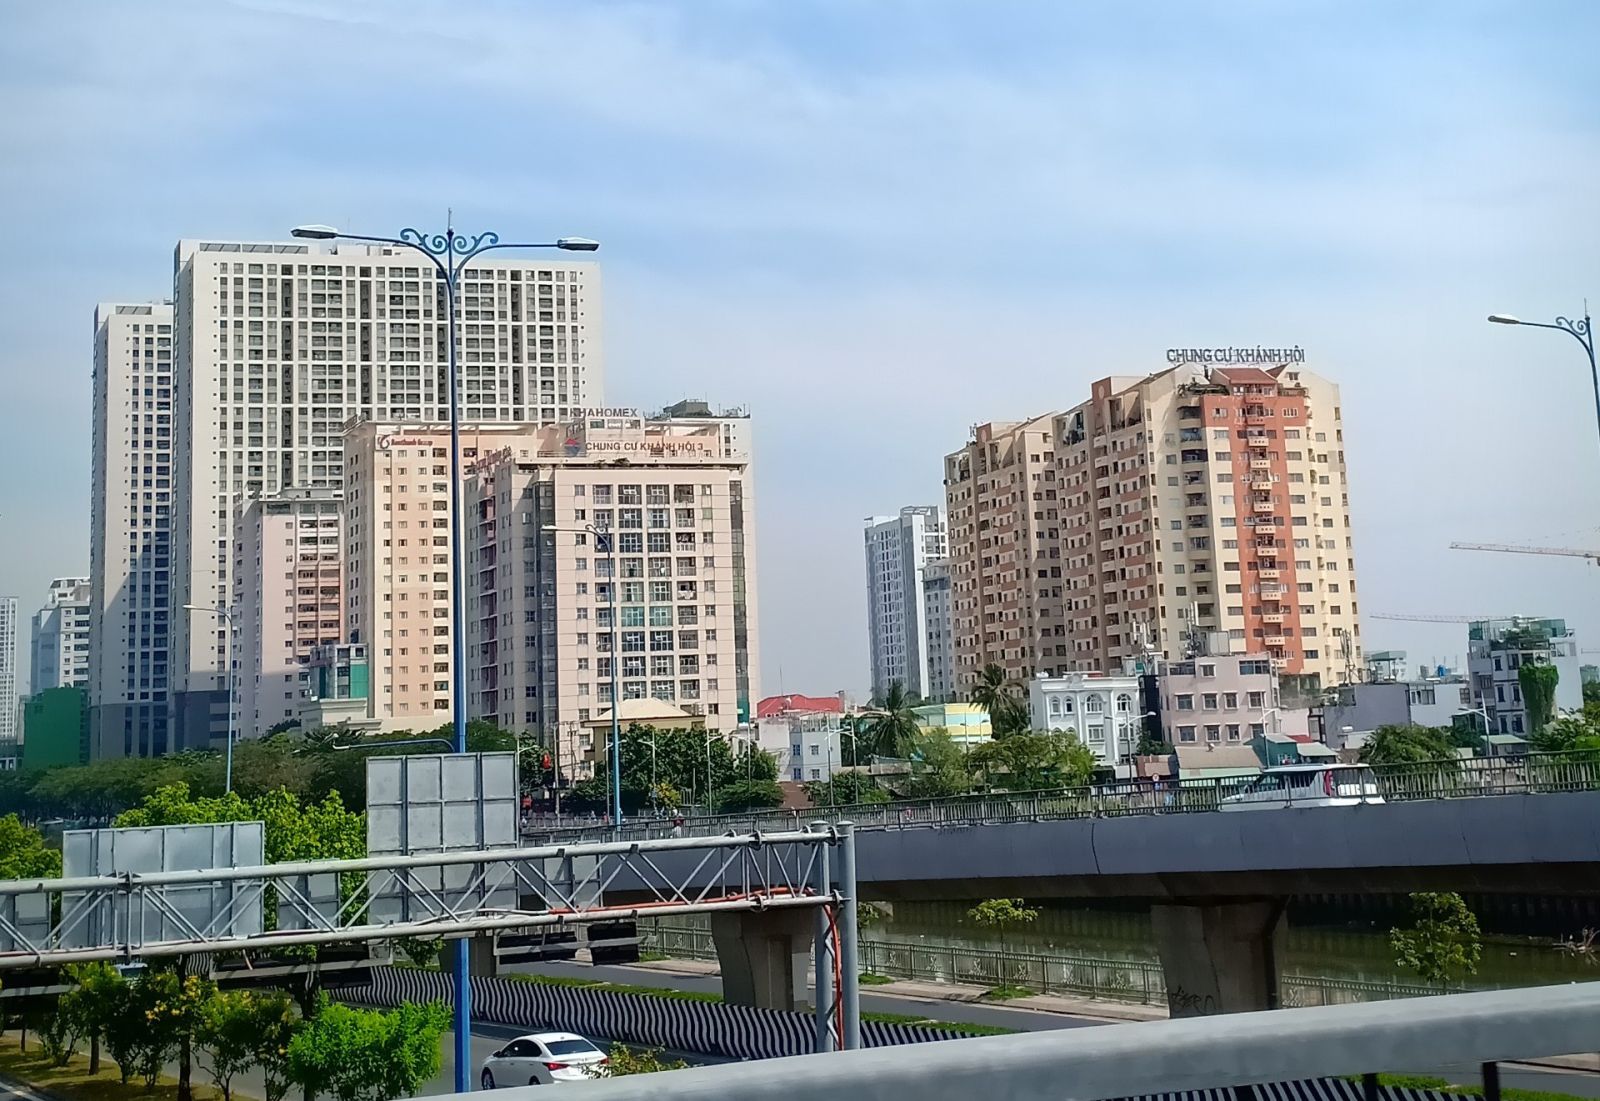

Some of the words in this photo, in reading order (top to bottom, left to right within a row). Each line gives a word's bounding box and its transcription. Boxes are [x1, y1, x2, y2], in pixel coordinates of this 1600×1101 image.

[1166, 348, 1212, 363] CHUNG
[1214, 346, 1233, 362] CƯ
[1237, 345, 1282, 362] KHÁNH
[1284, 345, 1305, 364] HỘI
[569, 408, 638, 417] KHAHOMEX
[585, 442, 621, 451] CHUNG
